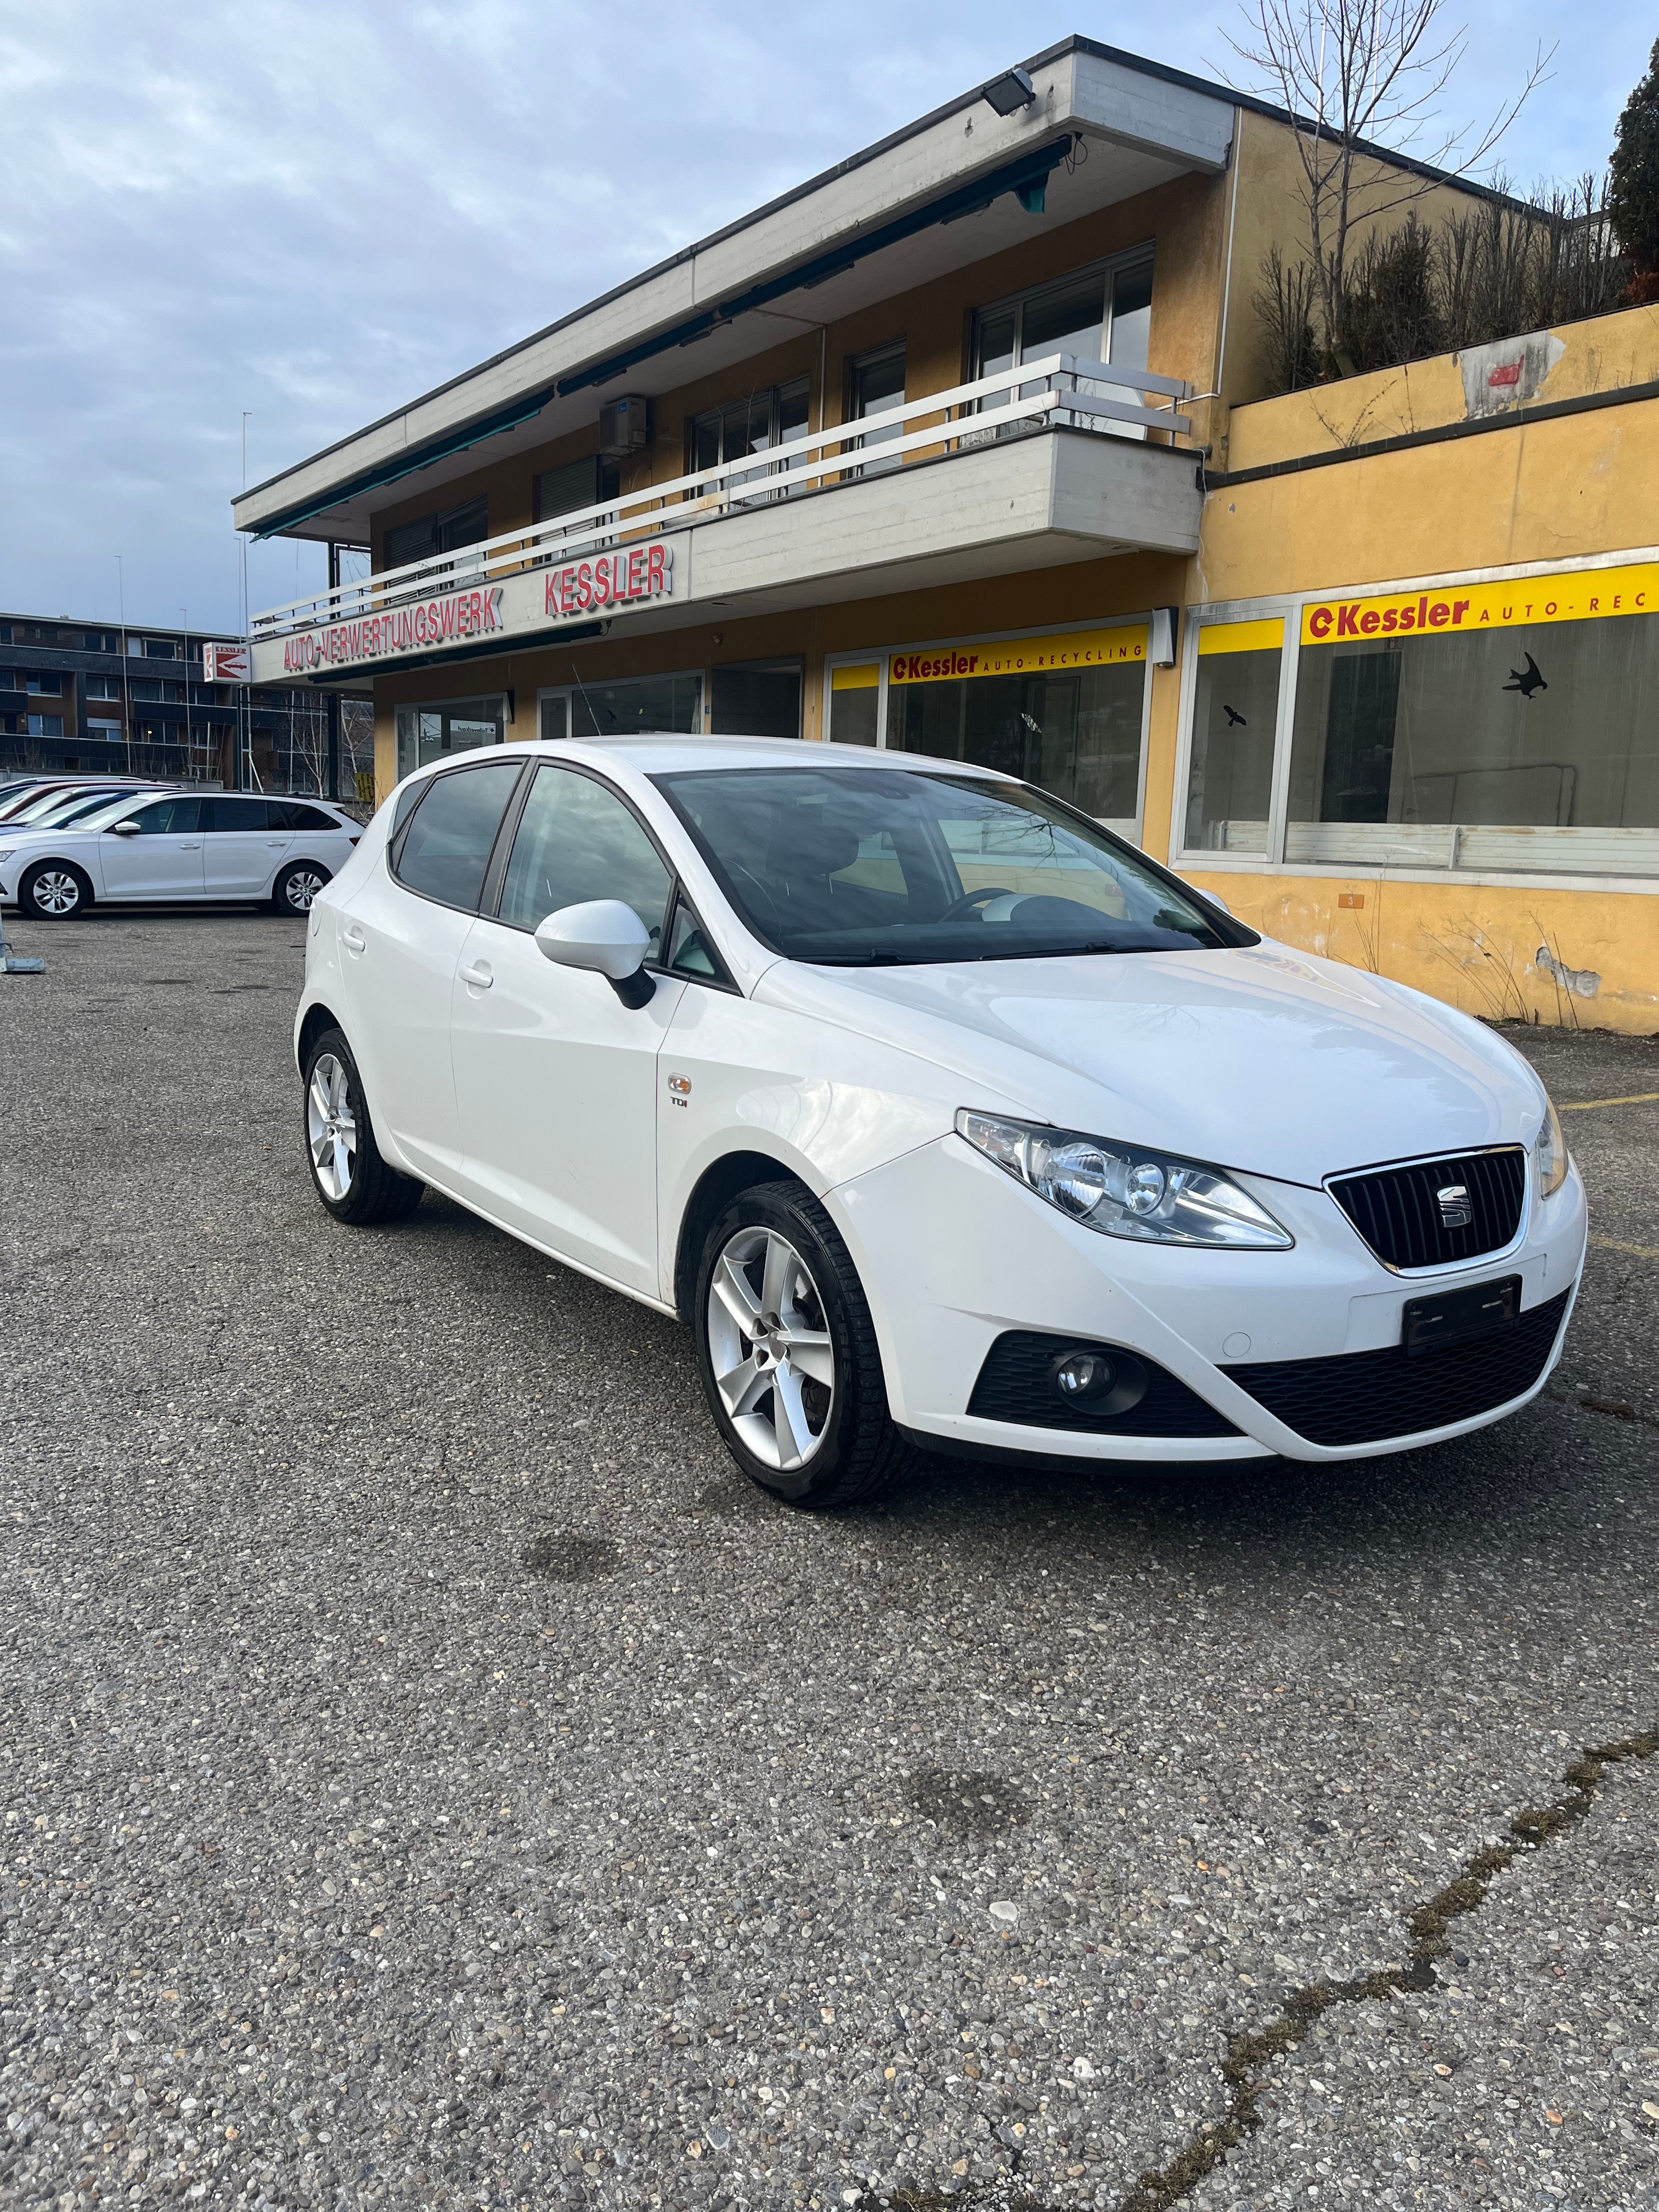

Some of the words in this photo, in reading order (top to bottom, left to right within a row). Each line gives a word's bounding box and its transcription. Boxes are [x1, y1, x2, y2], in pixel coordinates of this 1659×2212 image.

[284, 587, 499, 670] AUTO-VERWERTUNGSWERK
[545, 544, 670, 616] KESSLER
[1336, 596, 1470, 636] Kessler
[908, 651, 978, 679] Kessler
[983, 645, 1142, 672] AUTO-RECYCLING
[670, 1096, 687, 1107] TDI
